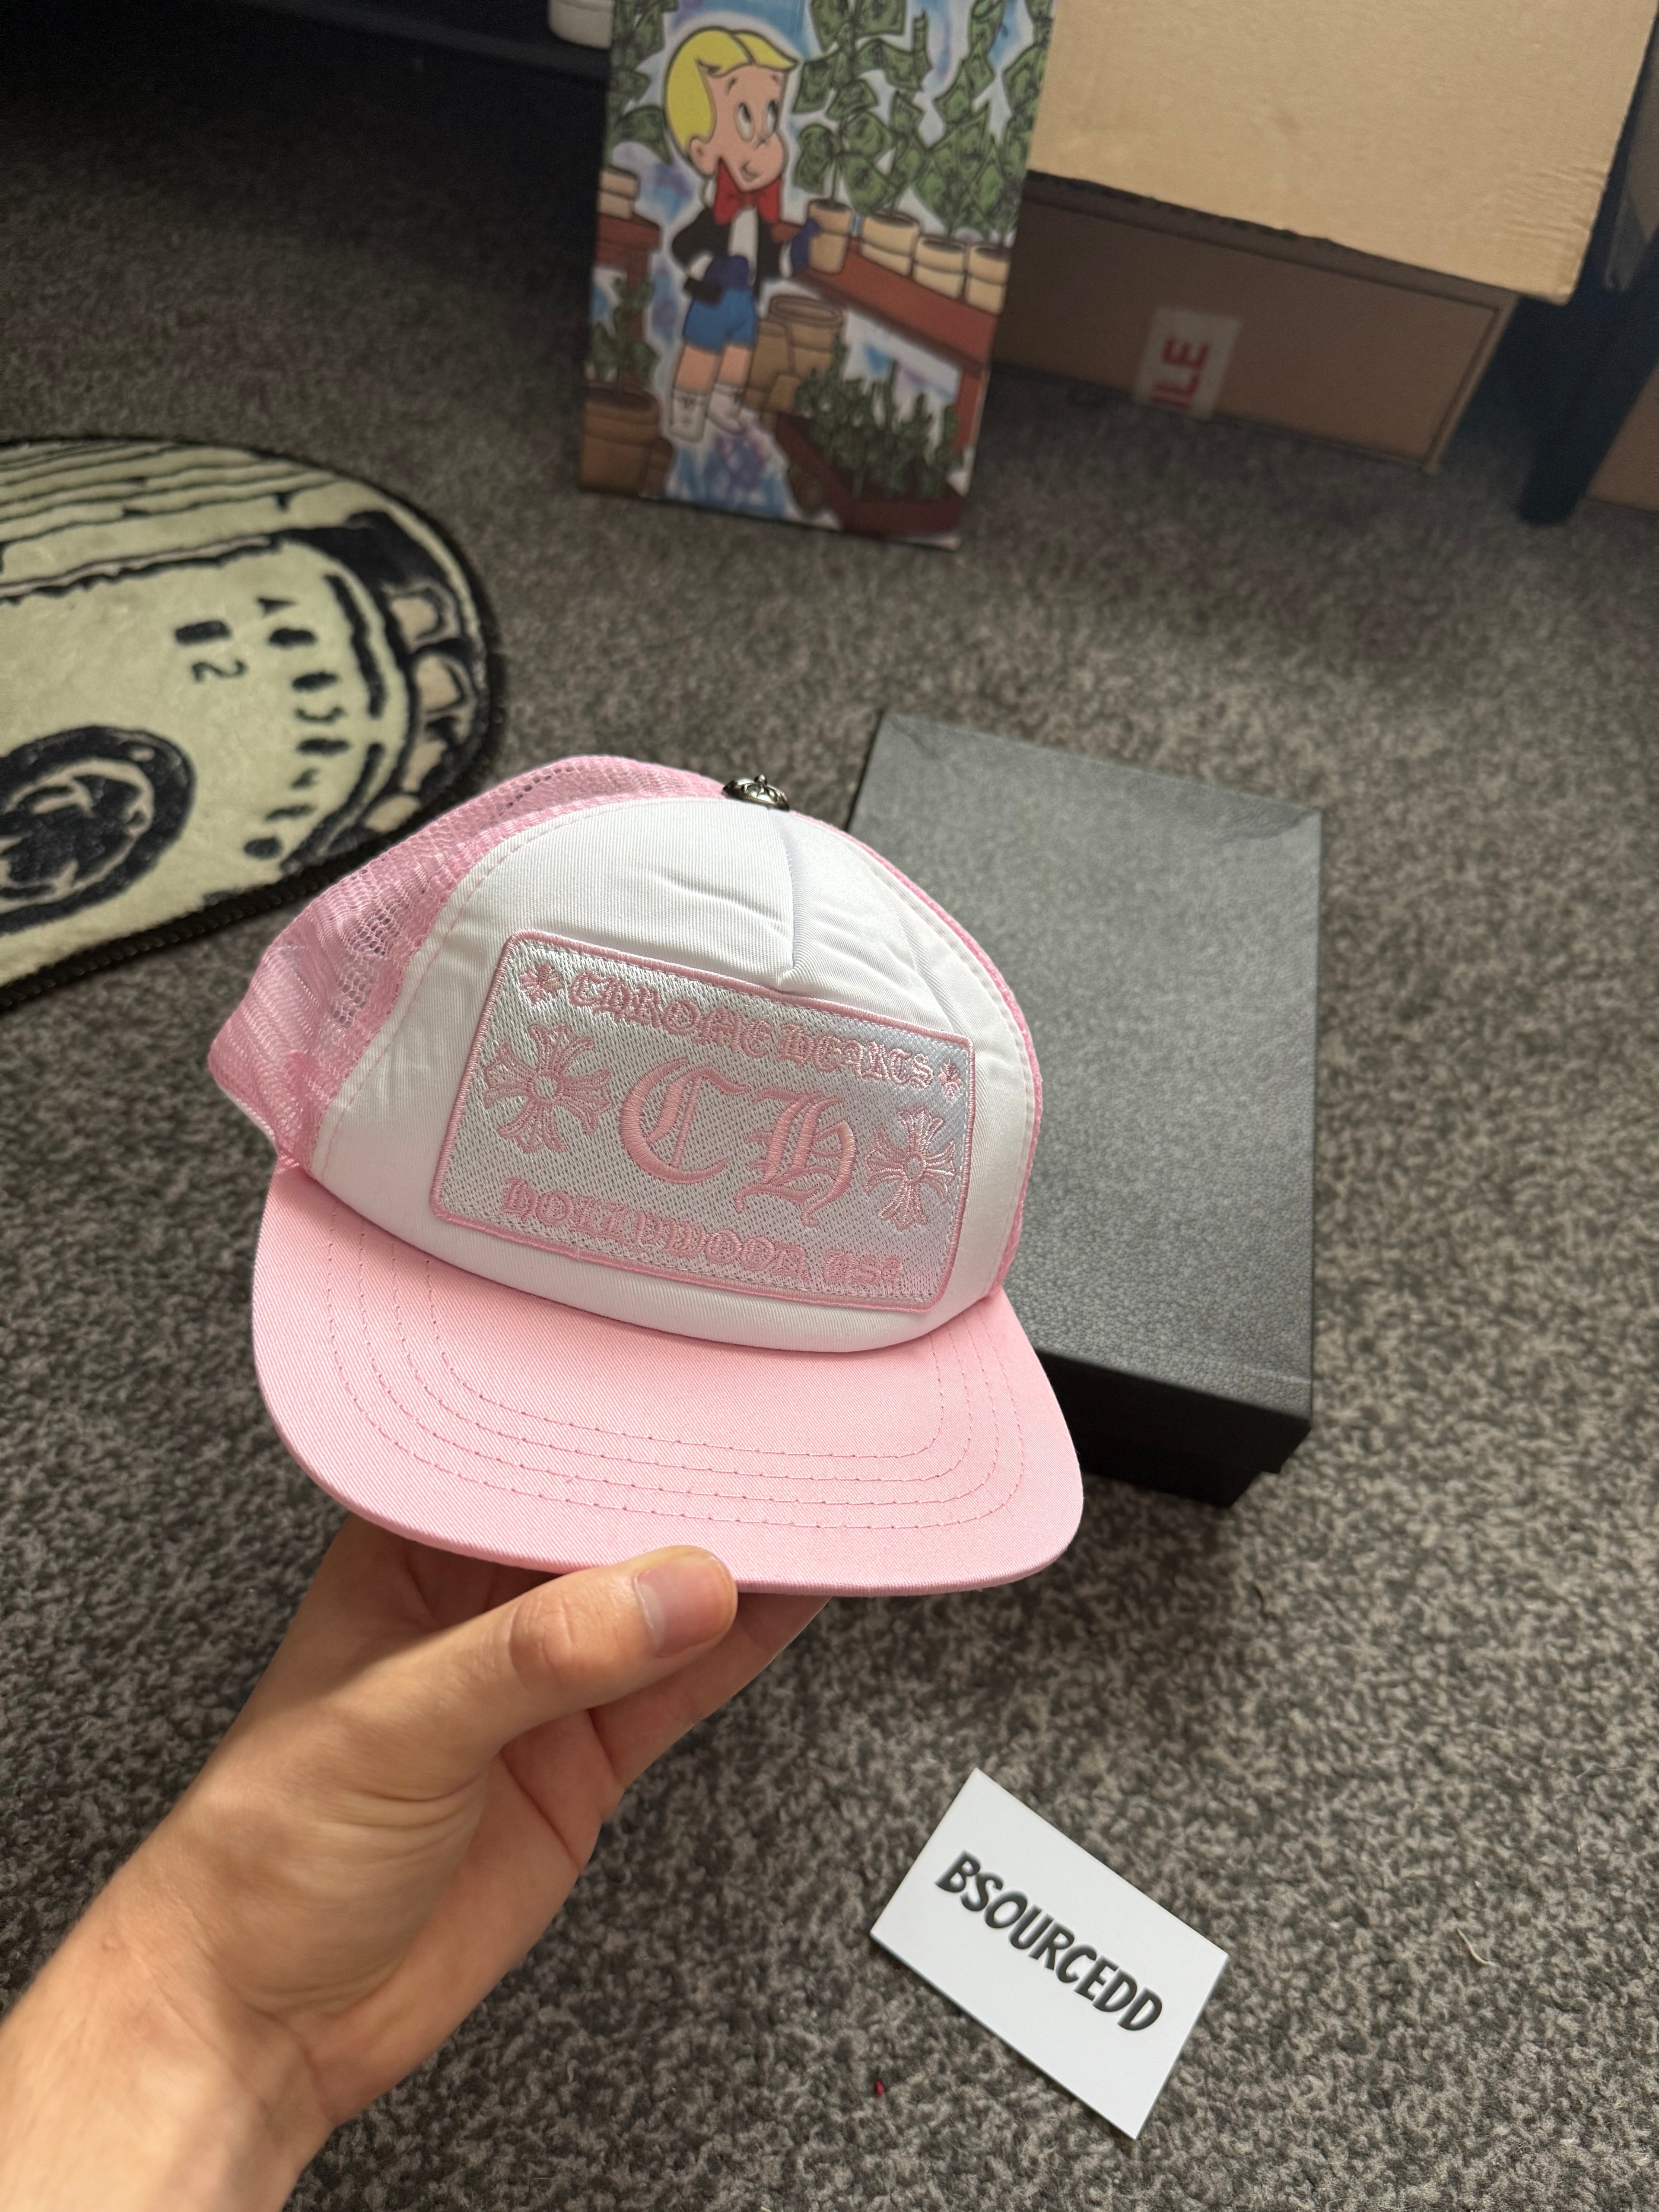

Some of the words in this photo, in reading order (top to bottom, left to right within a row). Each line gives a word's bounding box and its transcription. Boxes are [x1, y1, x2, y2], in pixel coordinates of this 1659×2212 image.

[569, 970, 772, 1058] CHROME
[777, 1023, 934, 1090] HEARTS
[501, 1177, 809, 1281] HOLLYWOOD
[934, 1850, 1163, 2031] BSOURCEDD
